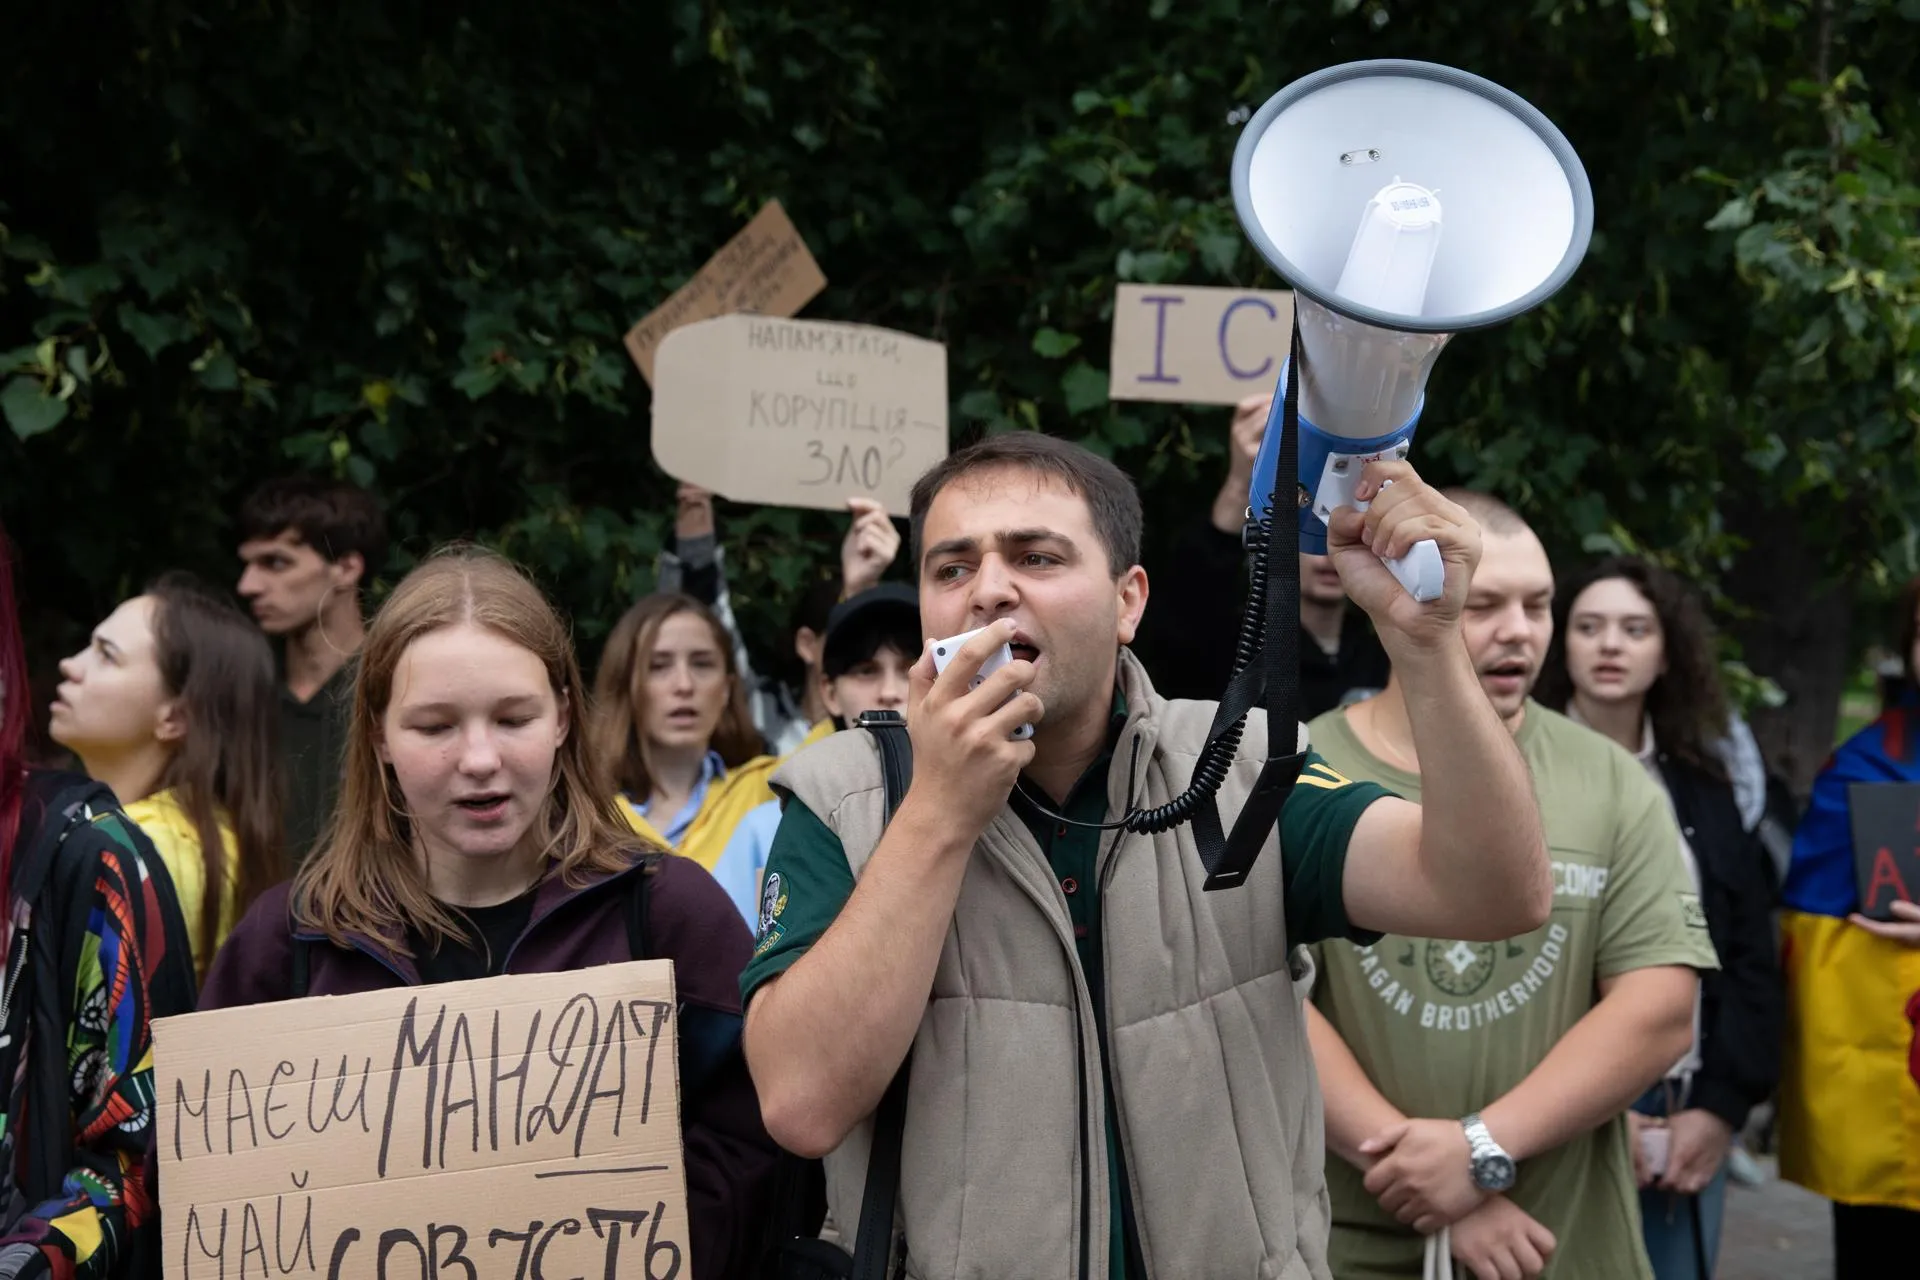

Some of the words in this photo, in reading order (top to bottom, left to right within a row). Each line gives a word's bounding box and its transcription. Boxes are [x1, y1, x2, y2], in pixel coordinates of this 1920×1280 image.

[799, 439, 906, 490] ЗЛО?
[1420, 923, 1568, 1030] BROTHERHOOD
[174, 1055, 369, 1162] МАЄШ
[377, 993, 673, 1179] МАНДАТ
[184, 1171, 316, 1280] МАЙ
